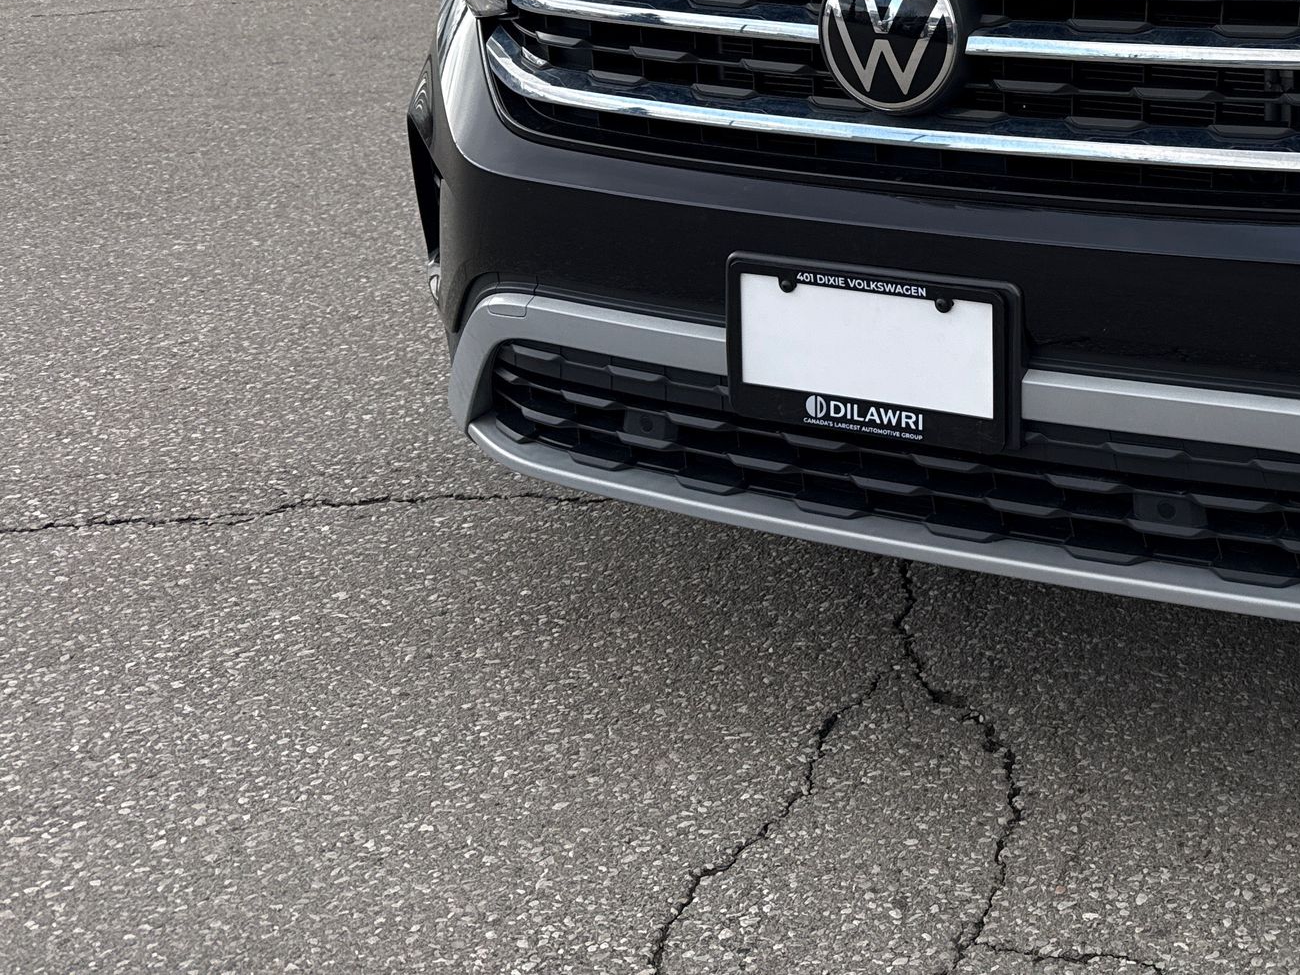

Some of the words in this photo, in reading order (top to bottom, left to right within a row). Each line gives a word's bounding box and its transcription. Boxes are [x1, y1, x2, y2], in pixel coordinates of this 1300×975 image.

[796, 272, 814, 283] 401
[816, 274, 846, 287] DIXIE
[847, 278, 926, 297] VOLKSWAGEN
[829, 400, 923, 431] DILAWRI
[803, 417, 833, 427] CANADA'S
[834, 421, 860, 431] LARGEST
[861, 426, 900, 437] AUTOMOTIVE
[901, 431, 923, 440] GROUP
